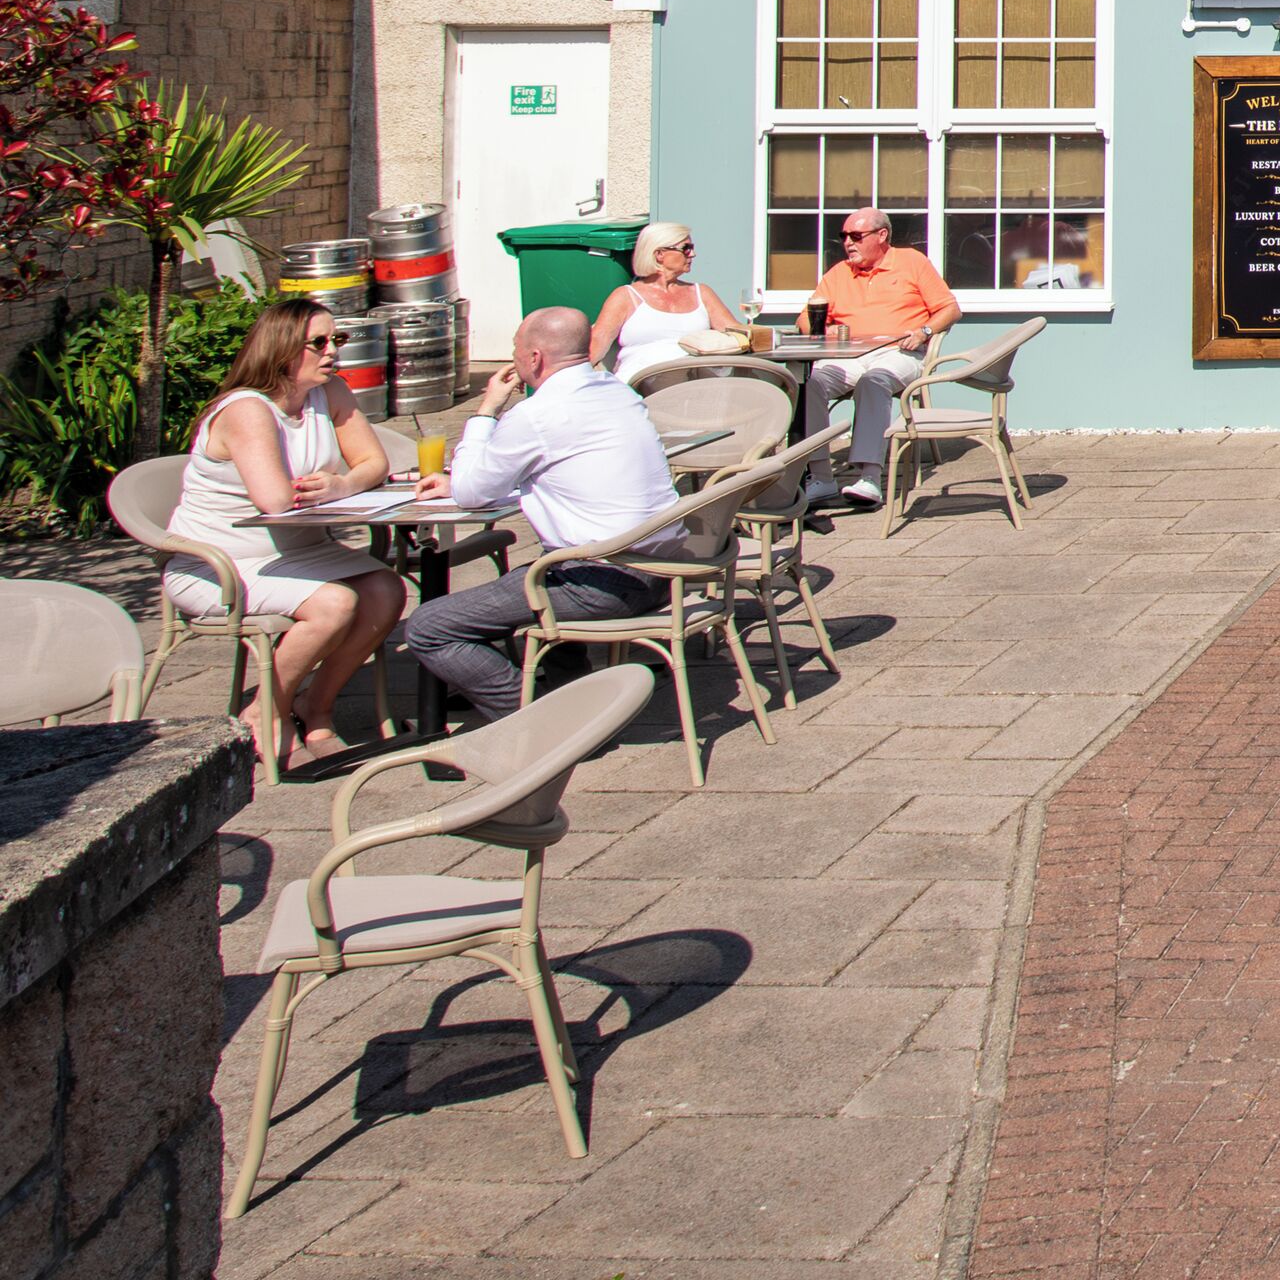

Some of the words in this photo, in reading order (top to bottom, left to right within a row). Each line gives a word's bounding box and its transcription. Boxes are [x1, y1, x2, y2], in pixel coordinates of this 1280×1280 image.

[514, 87, 536, 96] Fire
[514, 96, 535, 104] exit
[511, 105, 534, 113] Keep
[535, 105, 556, 113] clear
[1246, 120, 1276, 131] THE
[1235, 212, 1275, 221] LUXURY
[1248, 263, 1276, 272] BEER
